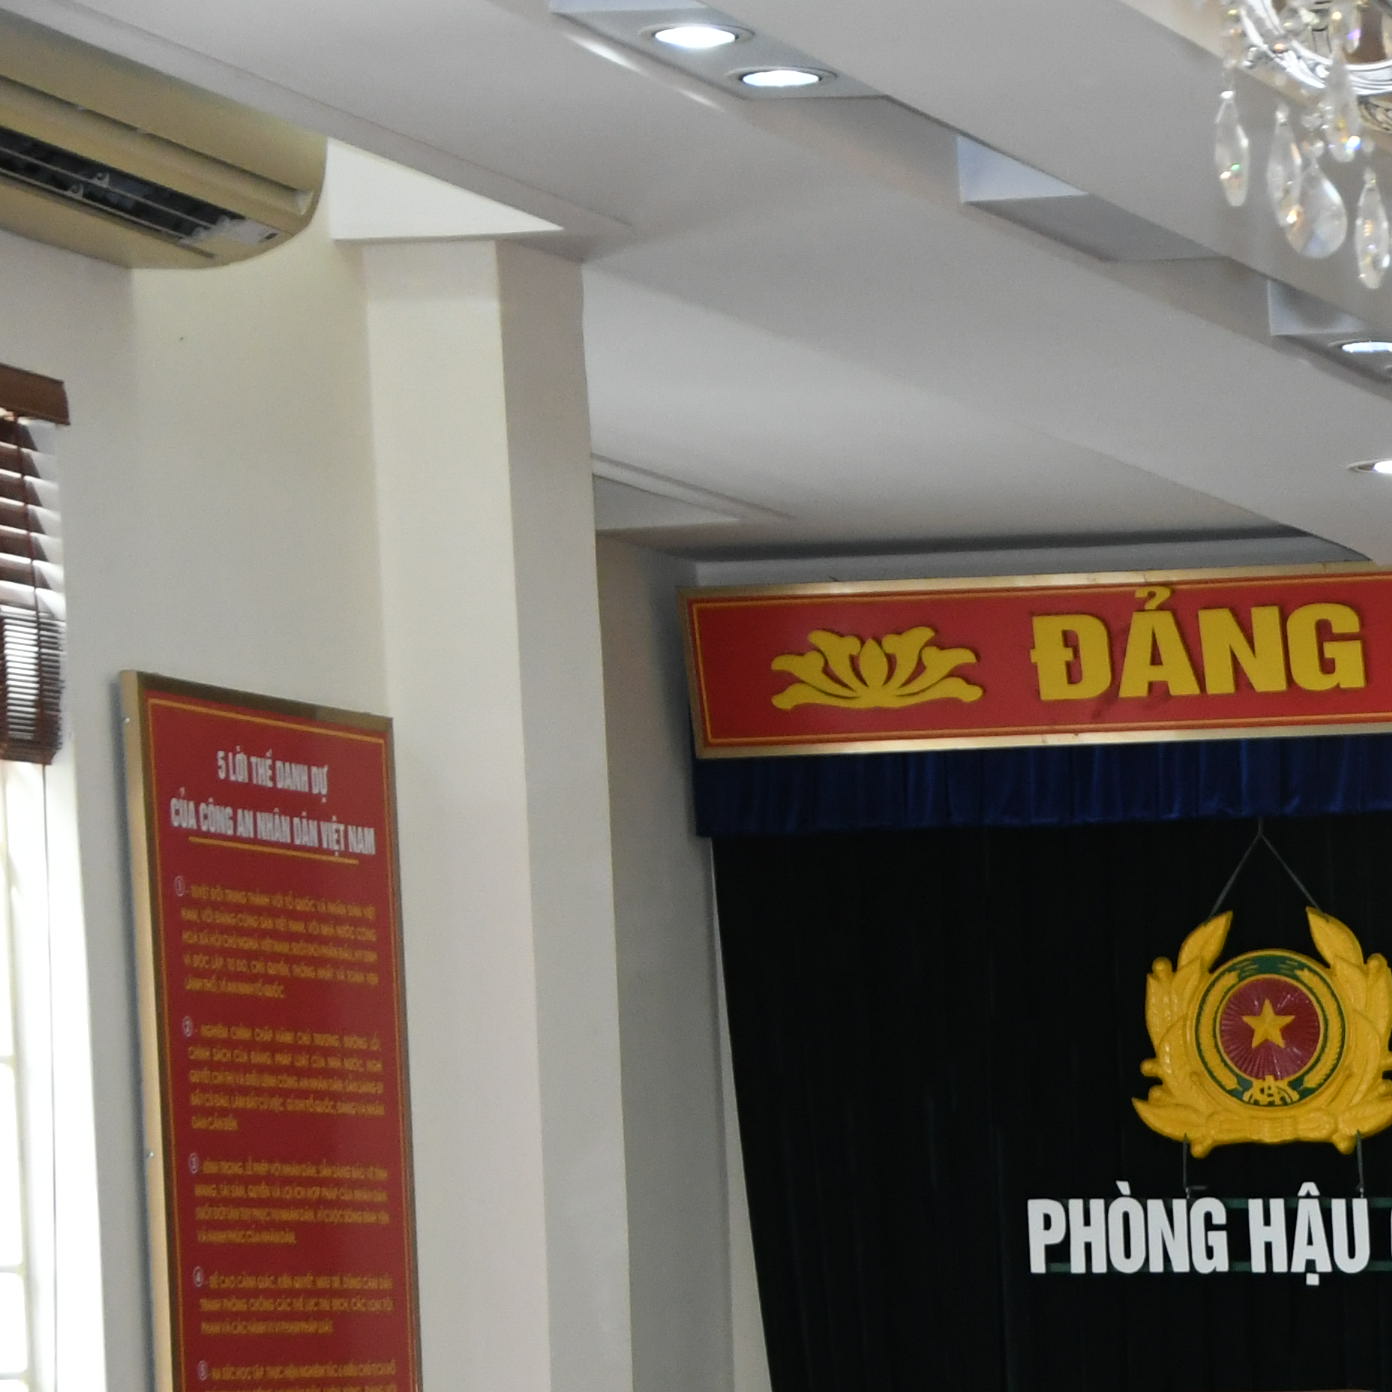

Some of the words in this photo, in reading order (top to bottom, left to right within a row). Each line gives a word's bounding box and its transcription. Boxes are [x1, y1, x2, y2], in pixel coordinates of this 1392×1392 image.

[1031, 587, 1365, 700] ĐẢNG
[217, 750, 226, 779] 5
[275, 760, 308, 792] DANH
[311, 765, 328, 803] DỰ
[170, 786, 198, 830] CỦA
[200, 797, 234, 836] CÔNG
[236, 808, 254, 839] AN
[256, 808, 291, 843] NHÂN
[293, 811, 319, 847] DÂN
[320, 815, 345, 857] VIỆT
[347, 825, 376, 855] NAM
[1028, 1181, 1229, 1274] PHÒNG
[1248, 1182, 1370, 1286] HẬU
